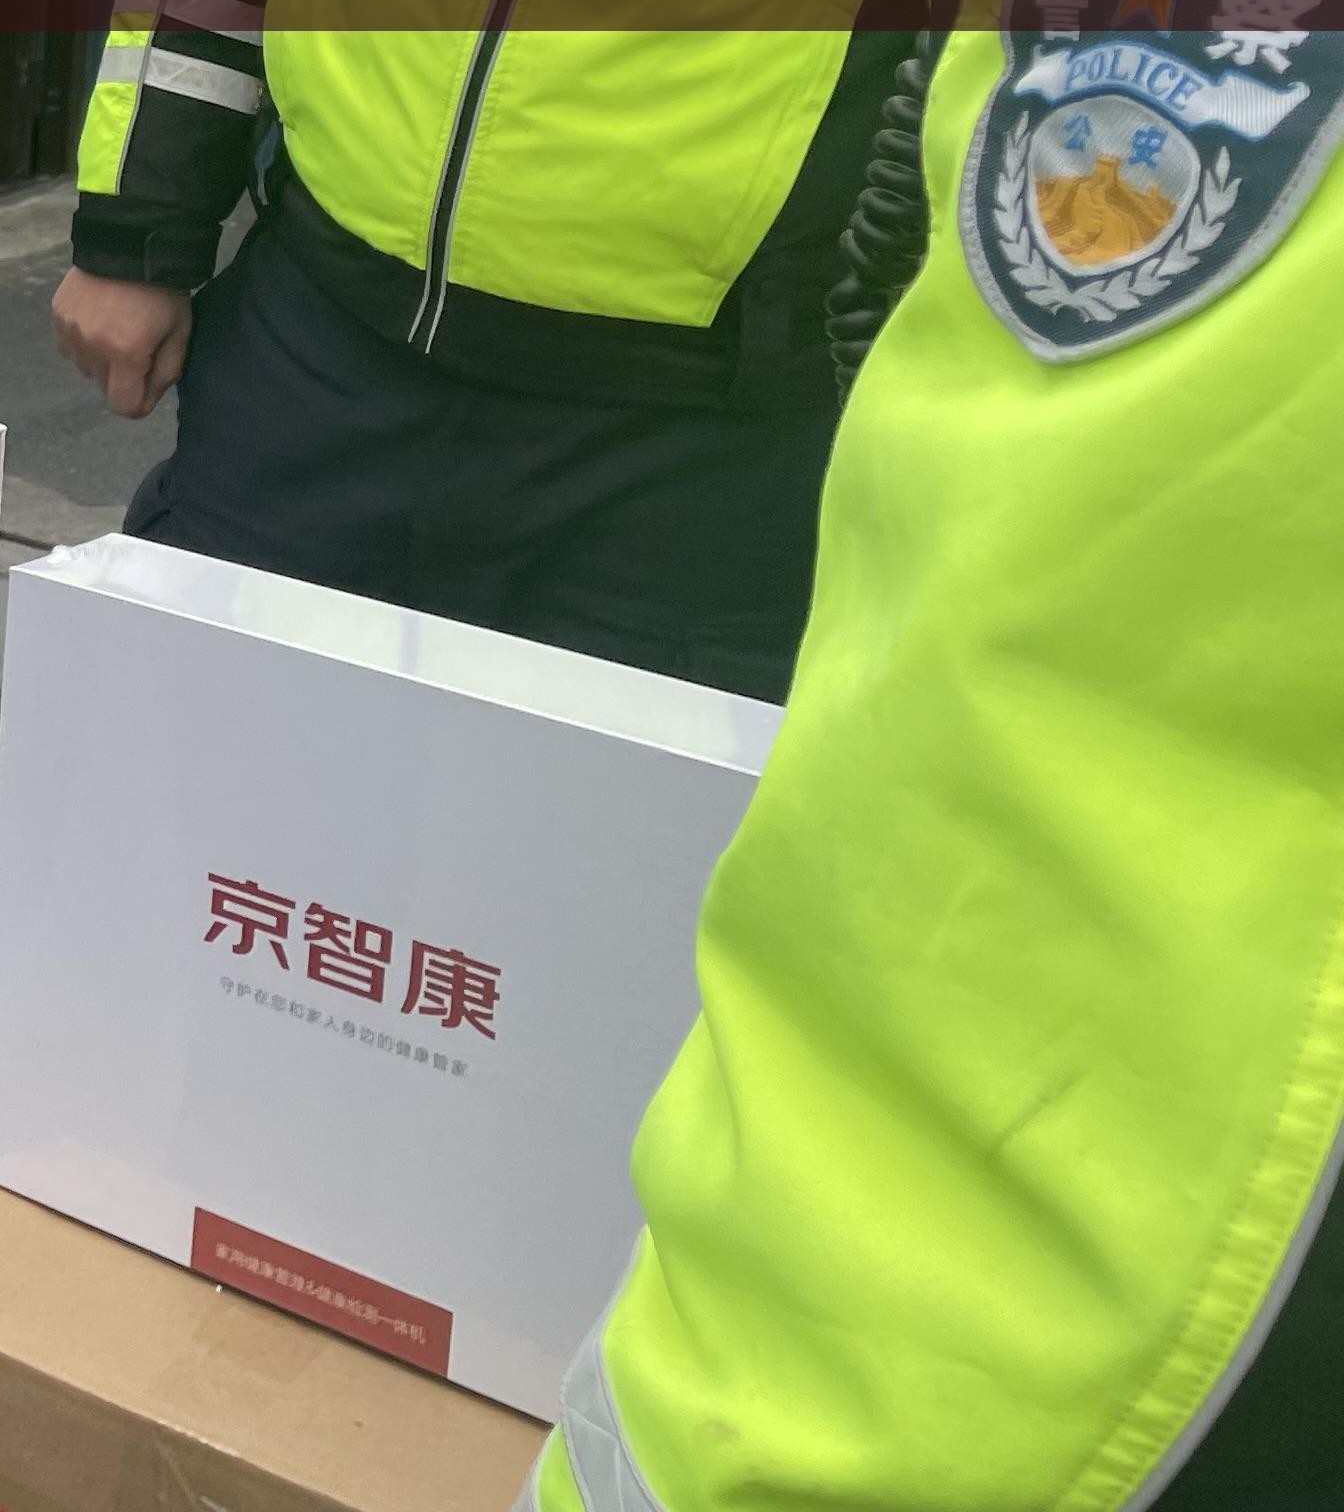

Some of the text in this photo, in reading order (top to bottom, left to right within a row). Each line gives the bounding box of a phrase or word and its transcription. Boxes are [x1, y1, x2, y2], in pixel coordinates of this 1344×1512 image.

[1066, 48, 1208, 115] POLICE
[203, 871, 502, 1040] 京智康
